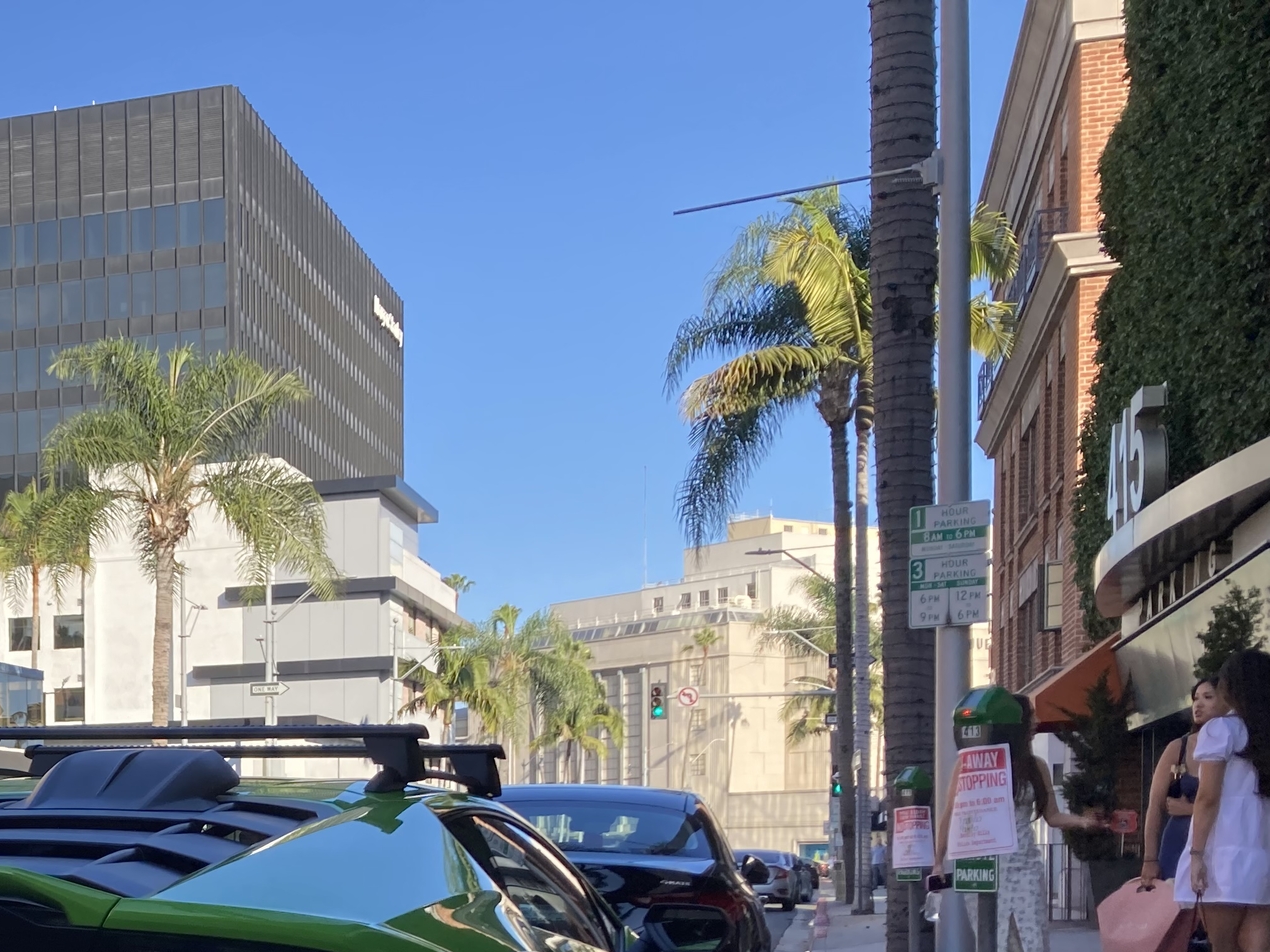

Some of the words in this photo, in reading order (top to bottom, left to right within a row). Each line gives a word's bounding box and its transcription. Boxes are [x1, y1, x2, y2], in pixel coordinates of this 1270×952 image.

[1107, 386, 1148, 534] 415
[941, 506, 968, 516] HOUR
[916, 510, 921, 528] 1
[934, 517, 976, 528] PARKING
[923, 532, 930, 542] 8
[931, 532, 943, 541] AM
[955, 528, 962, 539] 6
[964, 529, 976, 538] PM
[941, 559, 968, 568] HOUR
[912, 561, 924, 580] 3
[934, 568, 976, 580] PARKING
[920, 594, 926, 604] 6
[928, 594, 940, 603] PM
[956, 590, 968, 601] 12
[970, 591, 981, 600] PM
[920, 612, 926, 622] 9
[928, 613, 940, 622] PM
[957, 609, 964, 620] 6
[966, 609, 980, 618] PM
[964, 726, 980, 736] 413
[957, 868, 995, 882] PARKING
